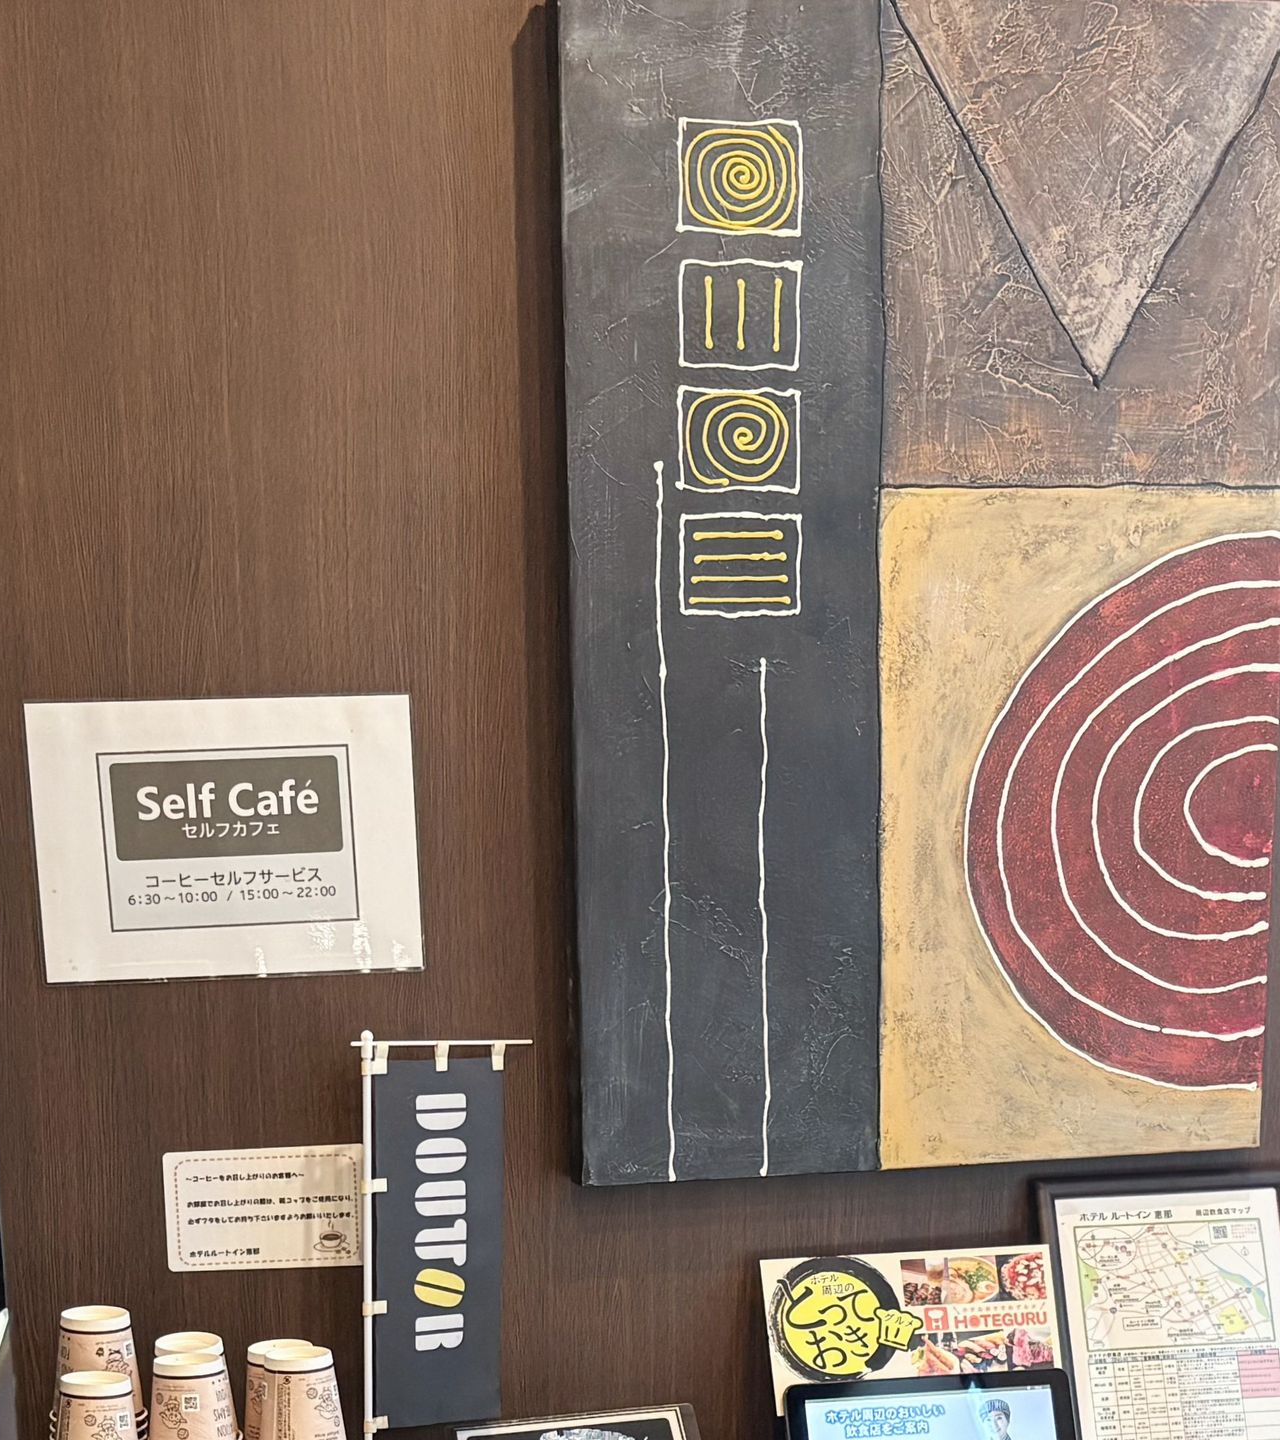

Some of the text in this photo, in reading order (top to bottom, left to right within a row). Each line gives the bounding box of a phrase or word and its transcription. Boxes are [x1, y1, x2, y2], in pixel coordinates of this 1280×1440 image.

[135, 779, 319, 821] Self Café
[181, 820, 281, 839] セルフカフェ
[144, 867, 323, 888] コーヒーセルフサービス
[1080, 1212, 1108, 1222] ホテル
[1111, 1210, 1151, 1220] ルートイン
[1195, 1206, 1251, 1217] 周辺飲食店マップ
[413, 1092, 468, 1352] DOUTOR
[811, 1273, 839, 1285] ホテル
[822, 1283, 855, 1296] 周辺の
[884, 1313, 915, 1327] グルメ
[954, 1311, 1048, 1330] HOTEGURU
[825, 1404, 946, 1424] ホテル周辺のおいしい
[844, 1420, 929, 1439] 飲食店をご案内
